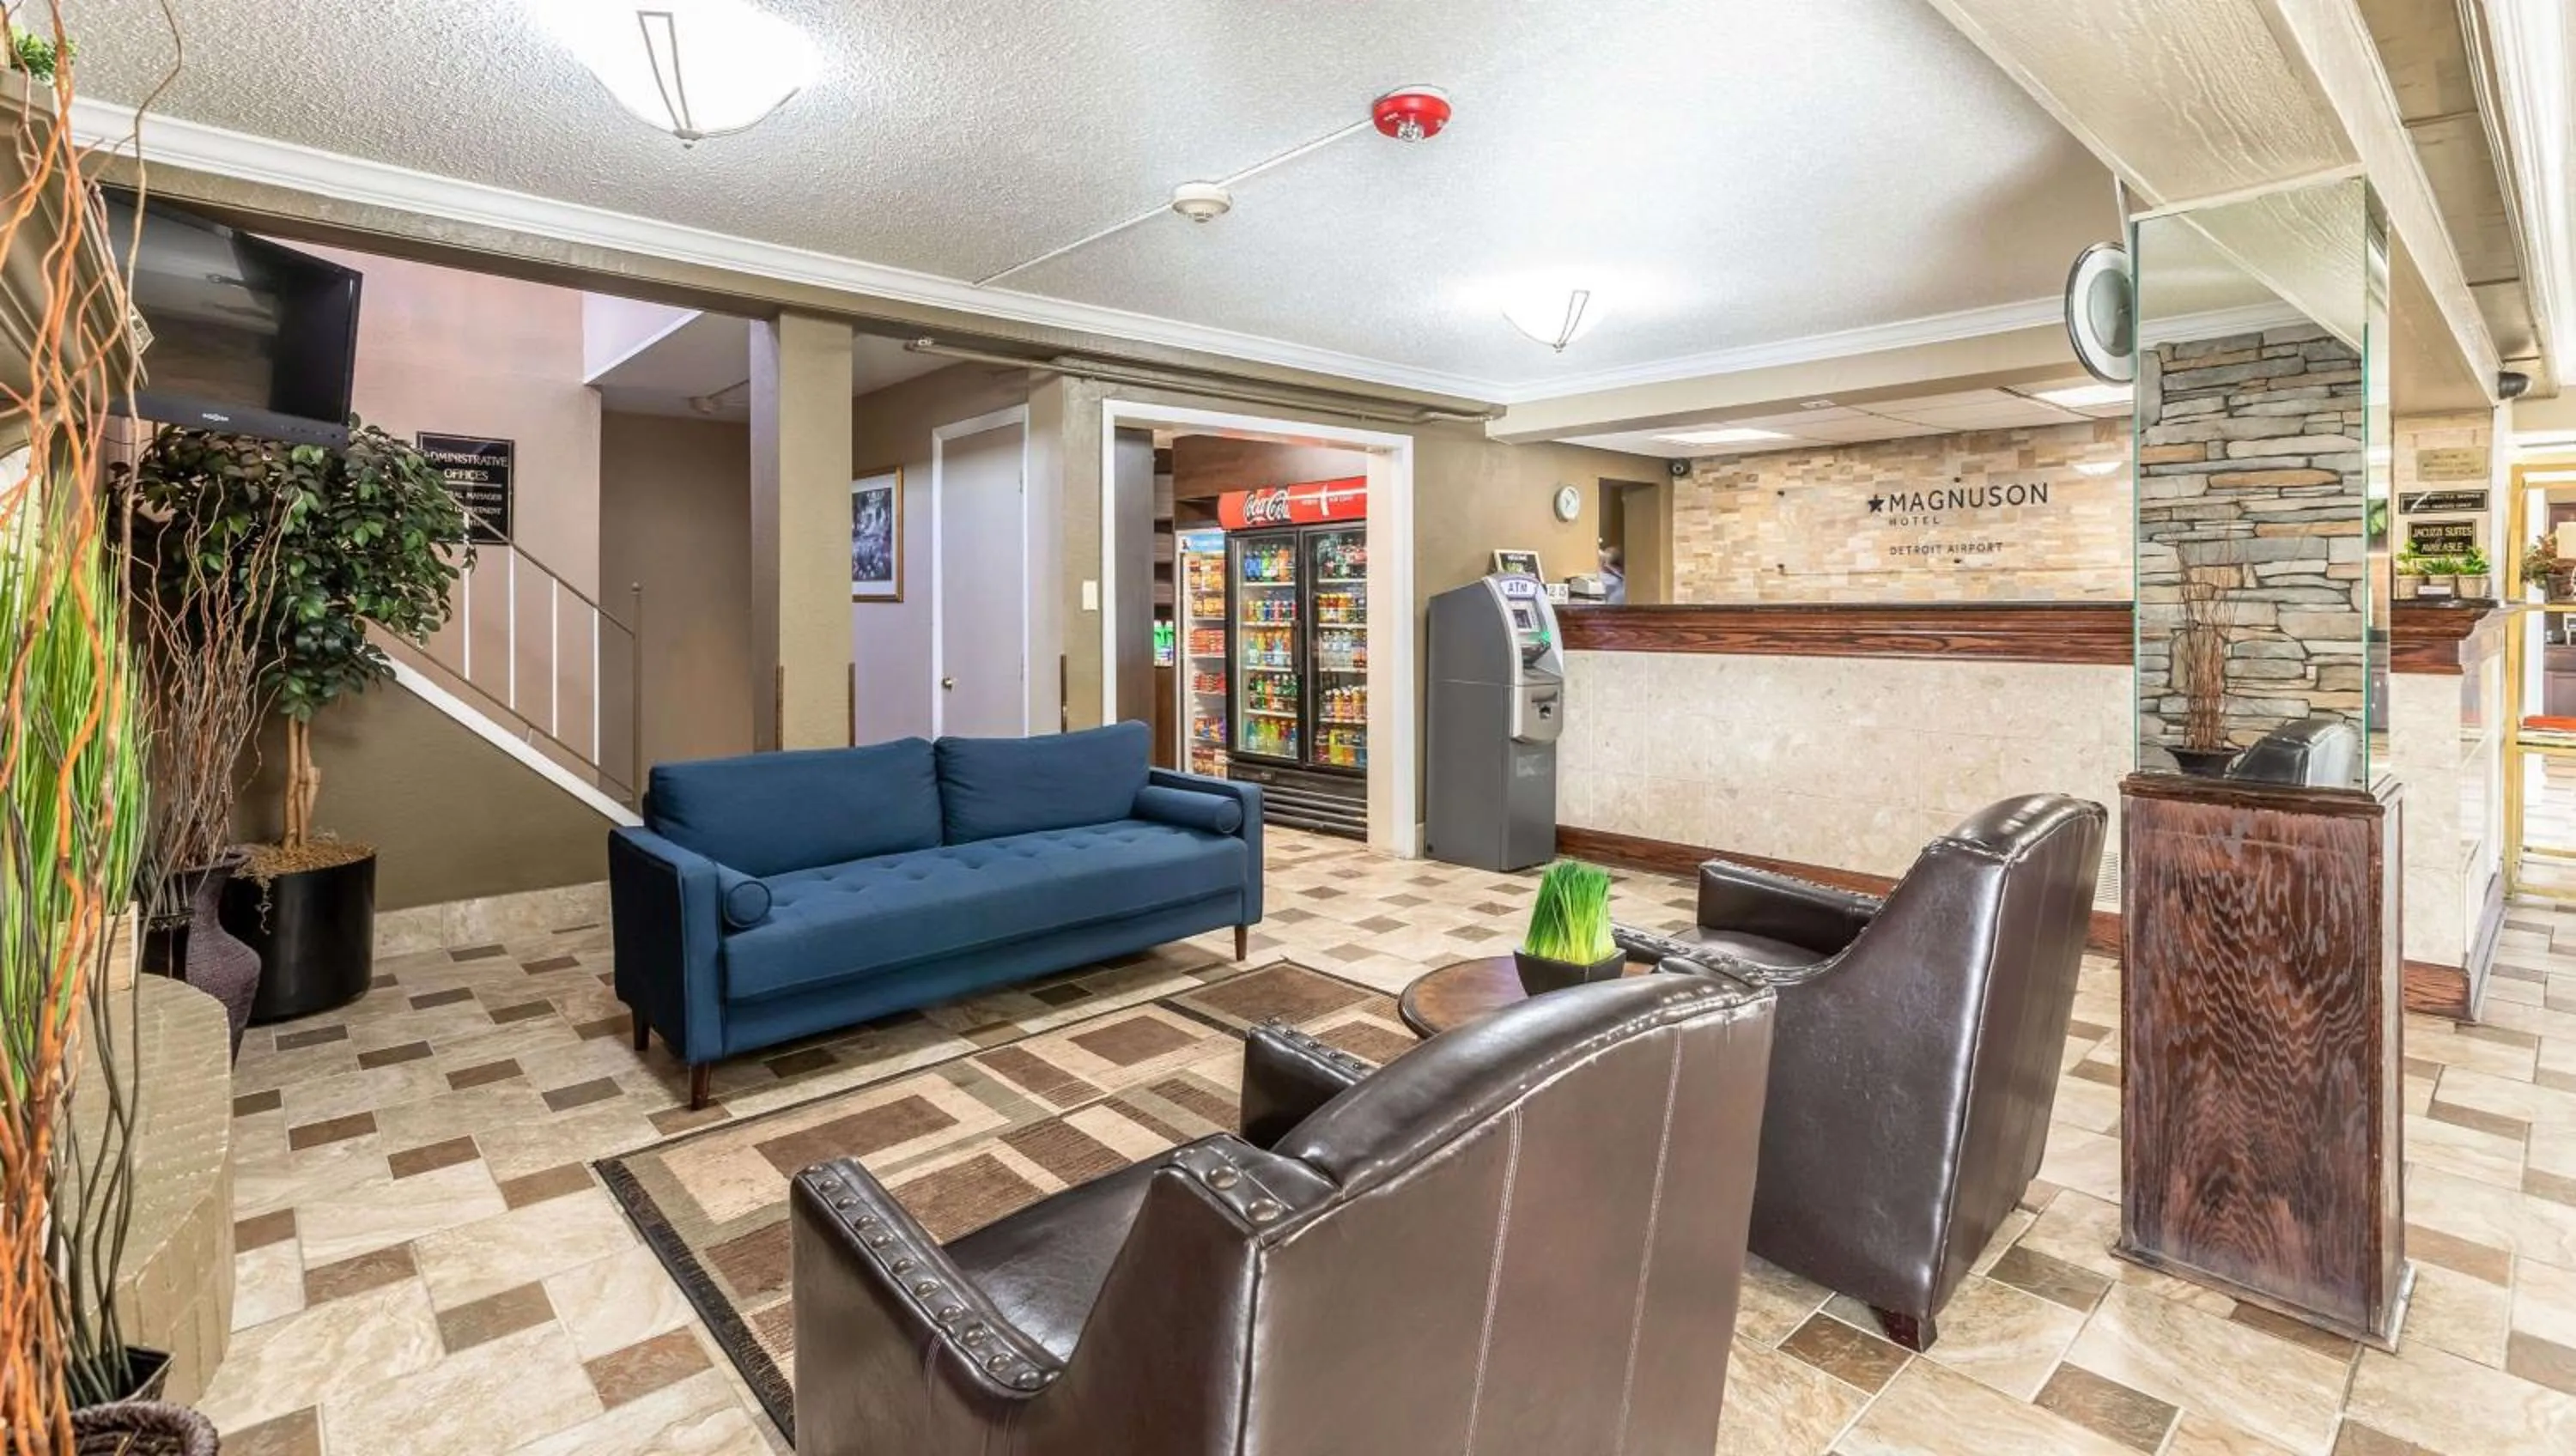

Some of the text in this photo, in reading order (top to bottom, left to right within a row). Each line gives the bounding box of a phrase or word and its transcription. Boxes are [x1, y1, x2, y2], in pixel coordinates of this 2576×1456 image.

[444, 468, 489, 481] OFFICES
[1889, 482, 2048, 513] MAGNUSON
[1888, 515, 1941, 527] HOTEL
[2413, 525, 2473, 538] JACUZZI SUITES
[1889, 541, 2003, 556] DETROIT AIRPORT
[1509, 582, 1528, 592] ATM
